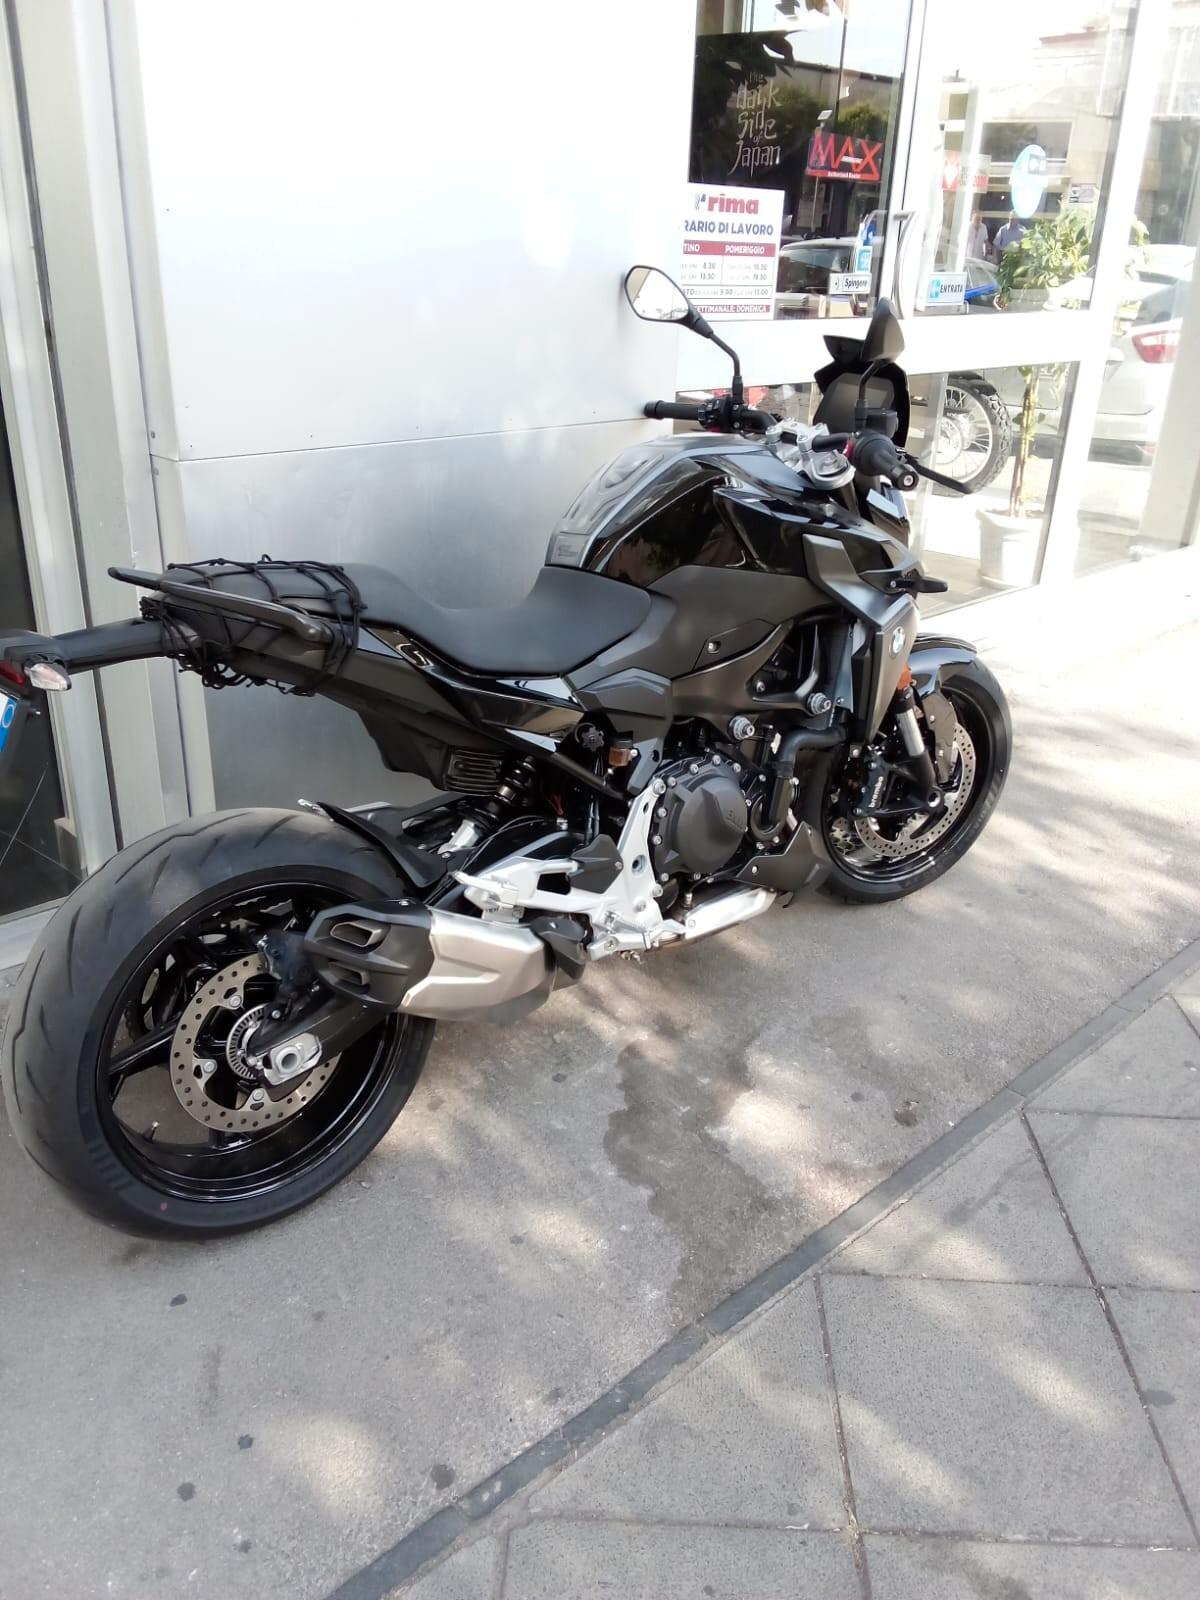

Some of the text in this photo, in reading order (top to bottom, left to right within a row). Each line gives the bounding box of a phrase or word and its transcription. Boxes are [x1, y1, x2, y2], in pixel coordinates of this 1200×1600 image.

[728, 140, 781, 177] Japan
[810, 132, 884, 172] MAX
[718, 221, 729, 234] DI
[731, 221, 774, 236] LAVORO
[725, 244, 765, 255] POMERIGGIO
[940, 283, 963, 293] ENTRATA
[867, 776, 884, 808] brembo
